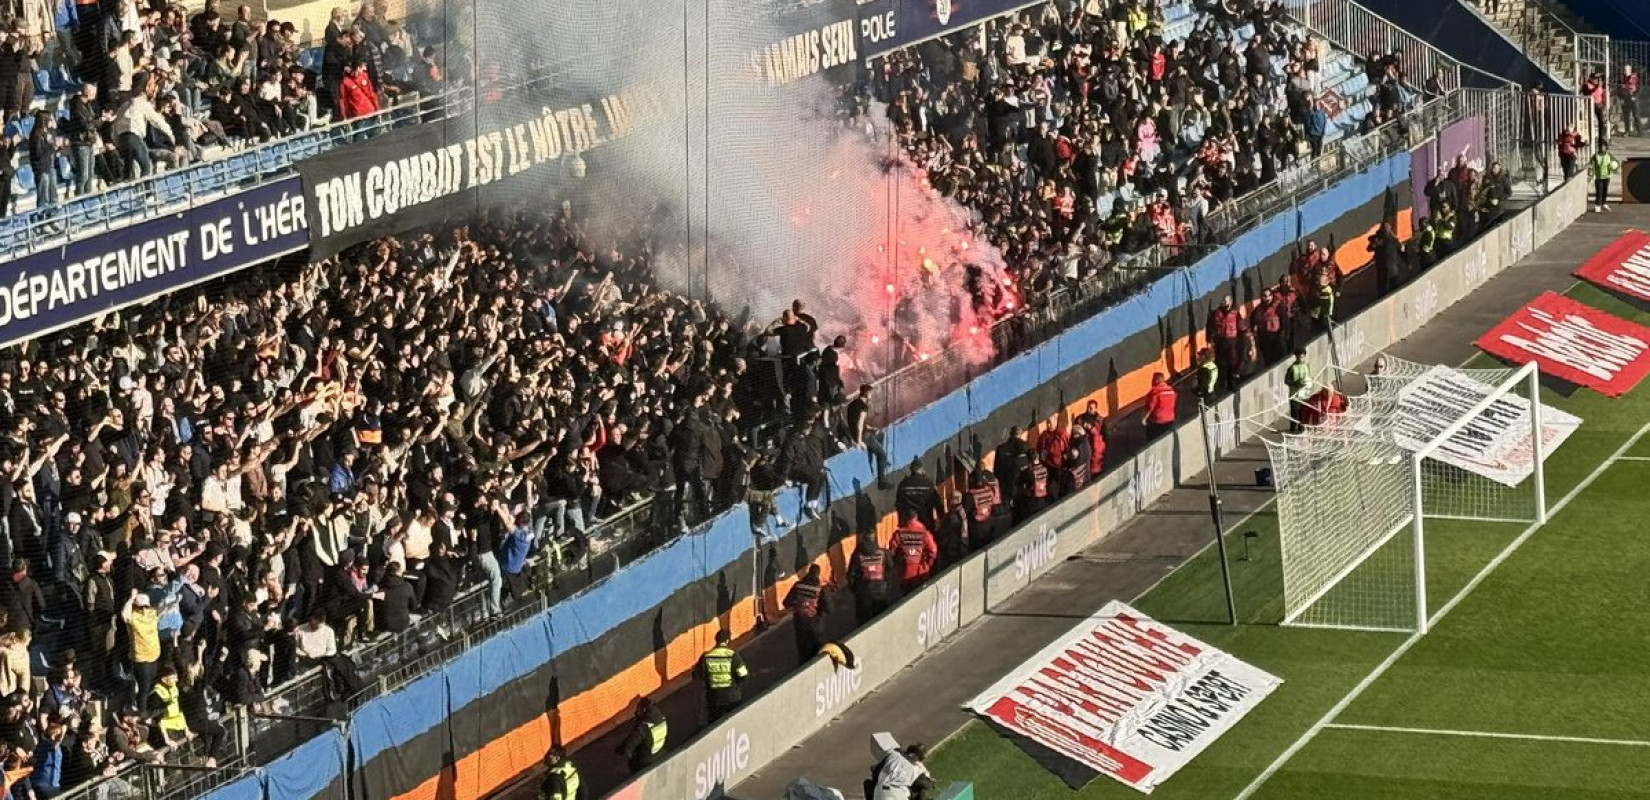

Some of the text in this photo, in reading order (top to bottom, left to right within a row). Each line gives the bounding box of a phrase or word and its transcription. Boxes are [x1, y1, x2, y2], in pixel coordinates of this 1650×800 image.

[862, 11, 896, 42] POLE
[314, 172, 364, 237] TON
[365, 144, 463, 219] COMBAT
[465, 131, 505, 188] EST
[505, 124, 531, 176] LE
[822, 19, 857, 69] SEUL
[200, 217, 233, 261] DE
[1015, 523, 1058, 581] swile
[917, 583, 960, 646] swile
[815, 656, 862, 717] swile
[1012, 612, 1204, 731] PARTOUCHE
[1136, 700, 1208, 752] CASINO
[1183, 668, 1253, 713] SPORT
[694, 727, 750, 800] swile
